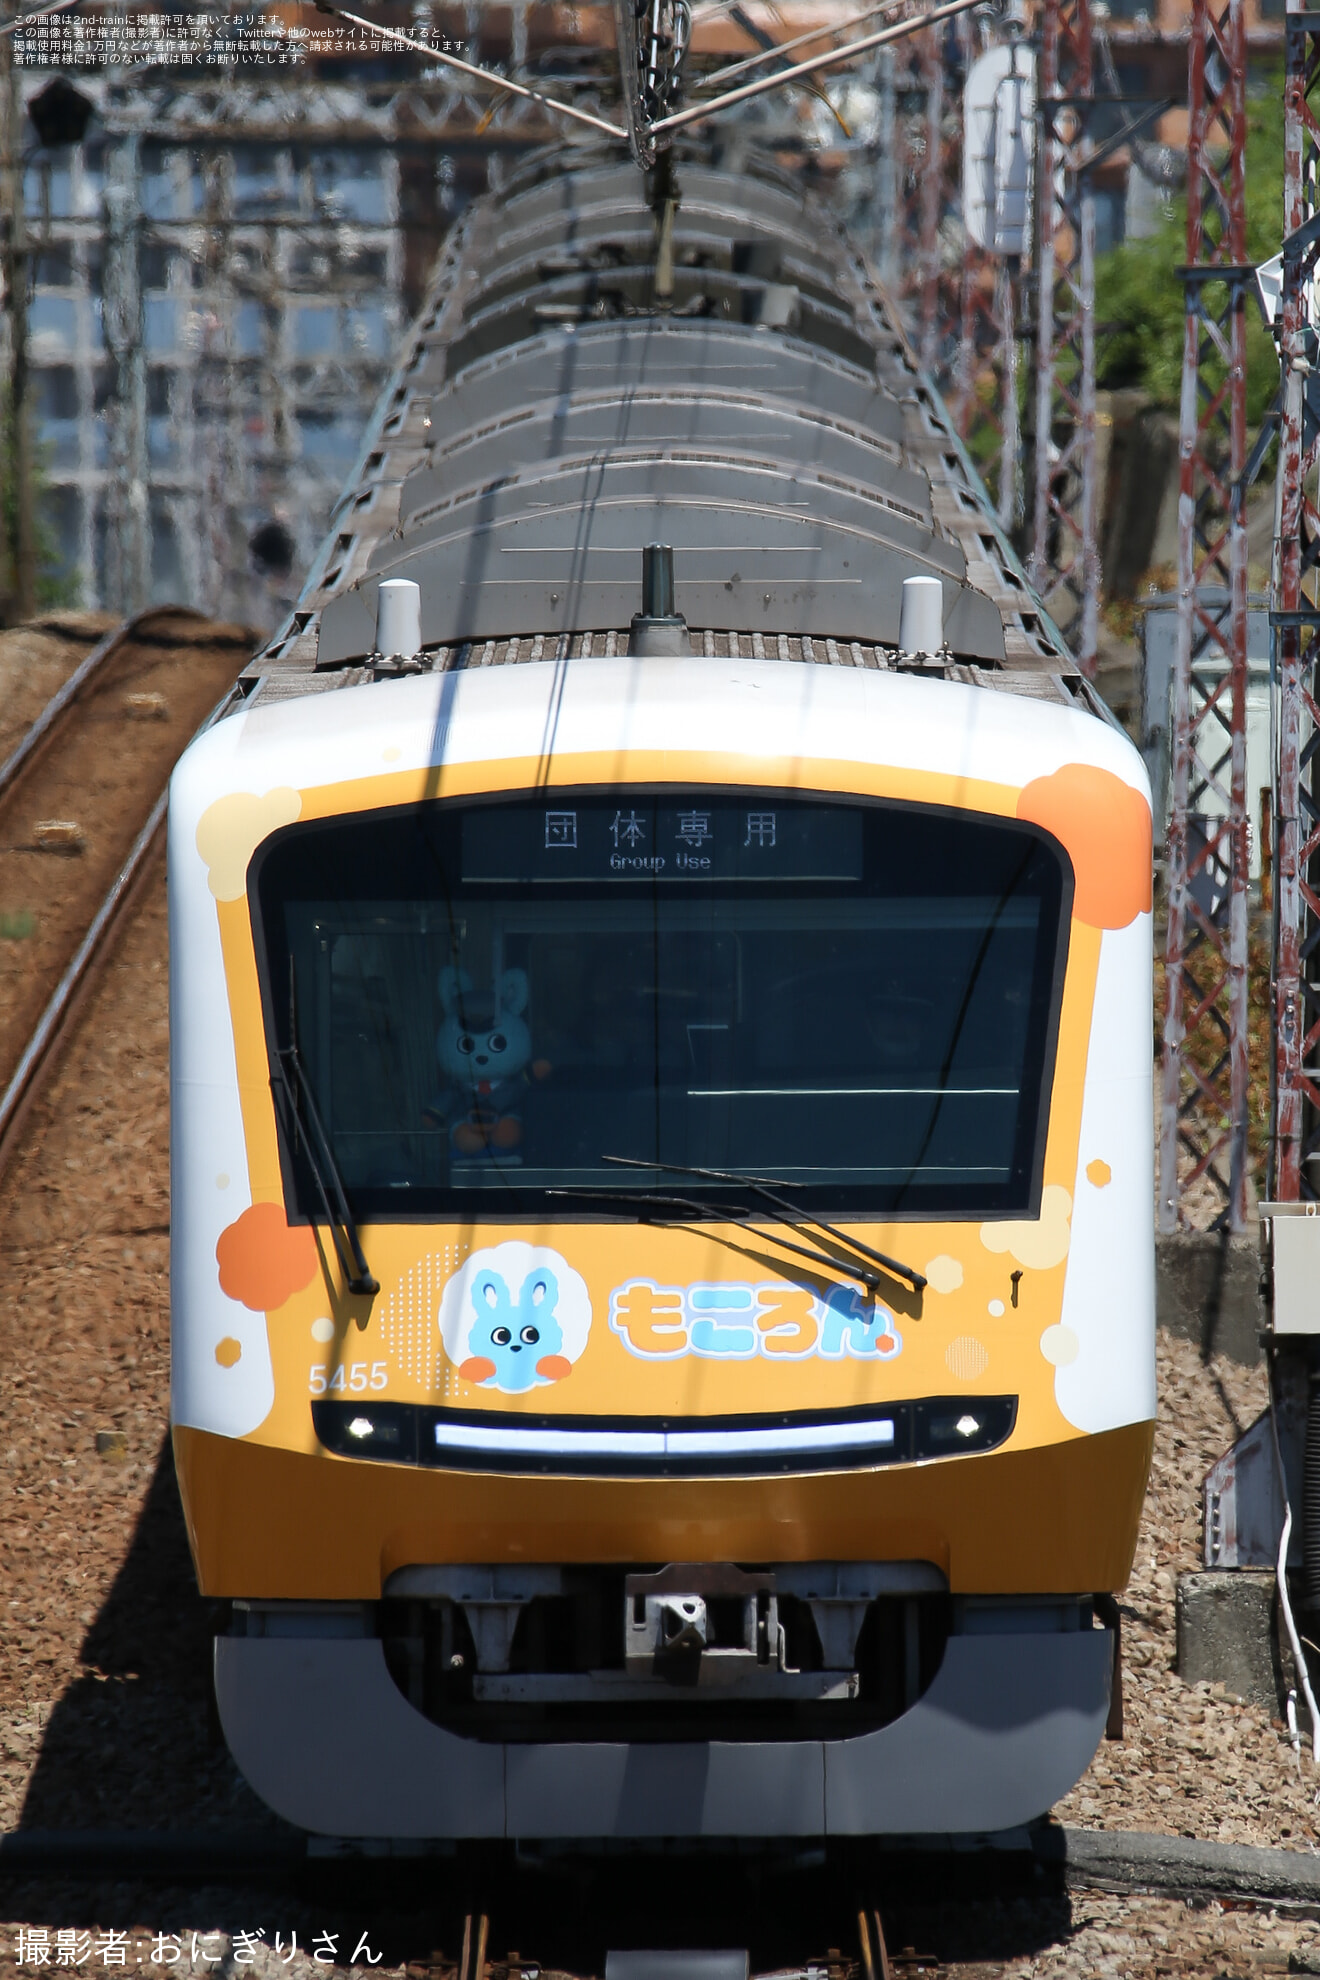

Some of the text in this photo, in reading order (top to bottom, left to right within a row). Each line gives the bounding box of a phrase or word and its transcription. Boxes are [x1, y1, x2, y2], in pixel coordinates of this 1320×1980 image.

[545, 810, 776, 848] 団体専用
[610, 853, 711, 873] Group Use
[611, 1280, 900, 1358] もころん
[308, 1361, 389, 1395] 5455
